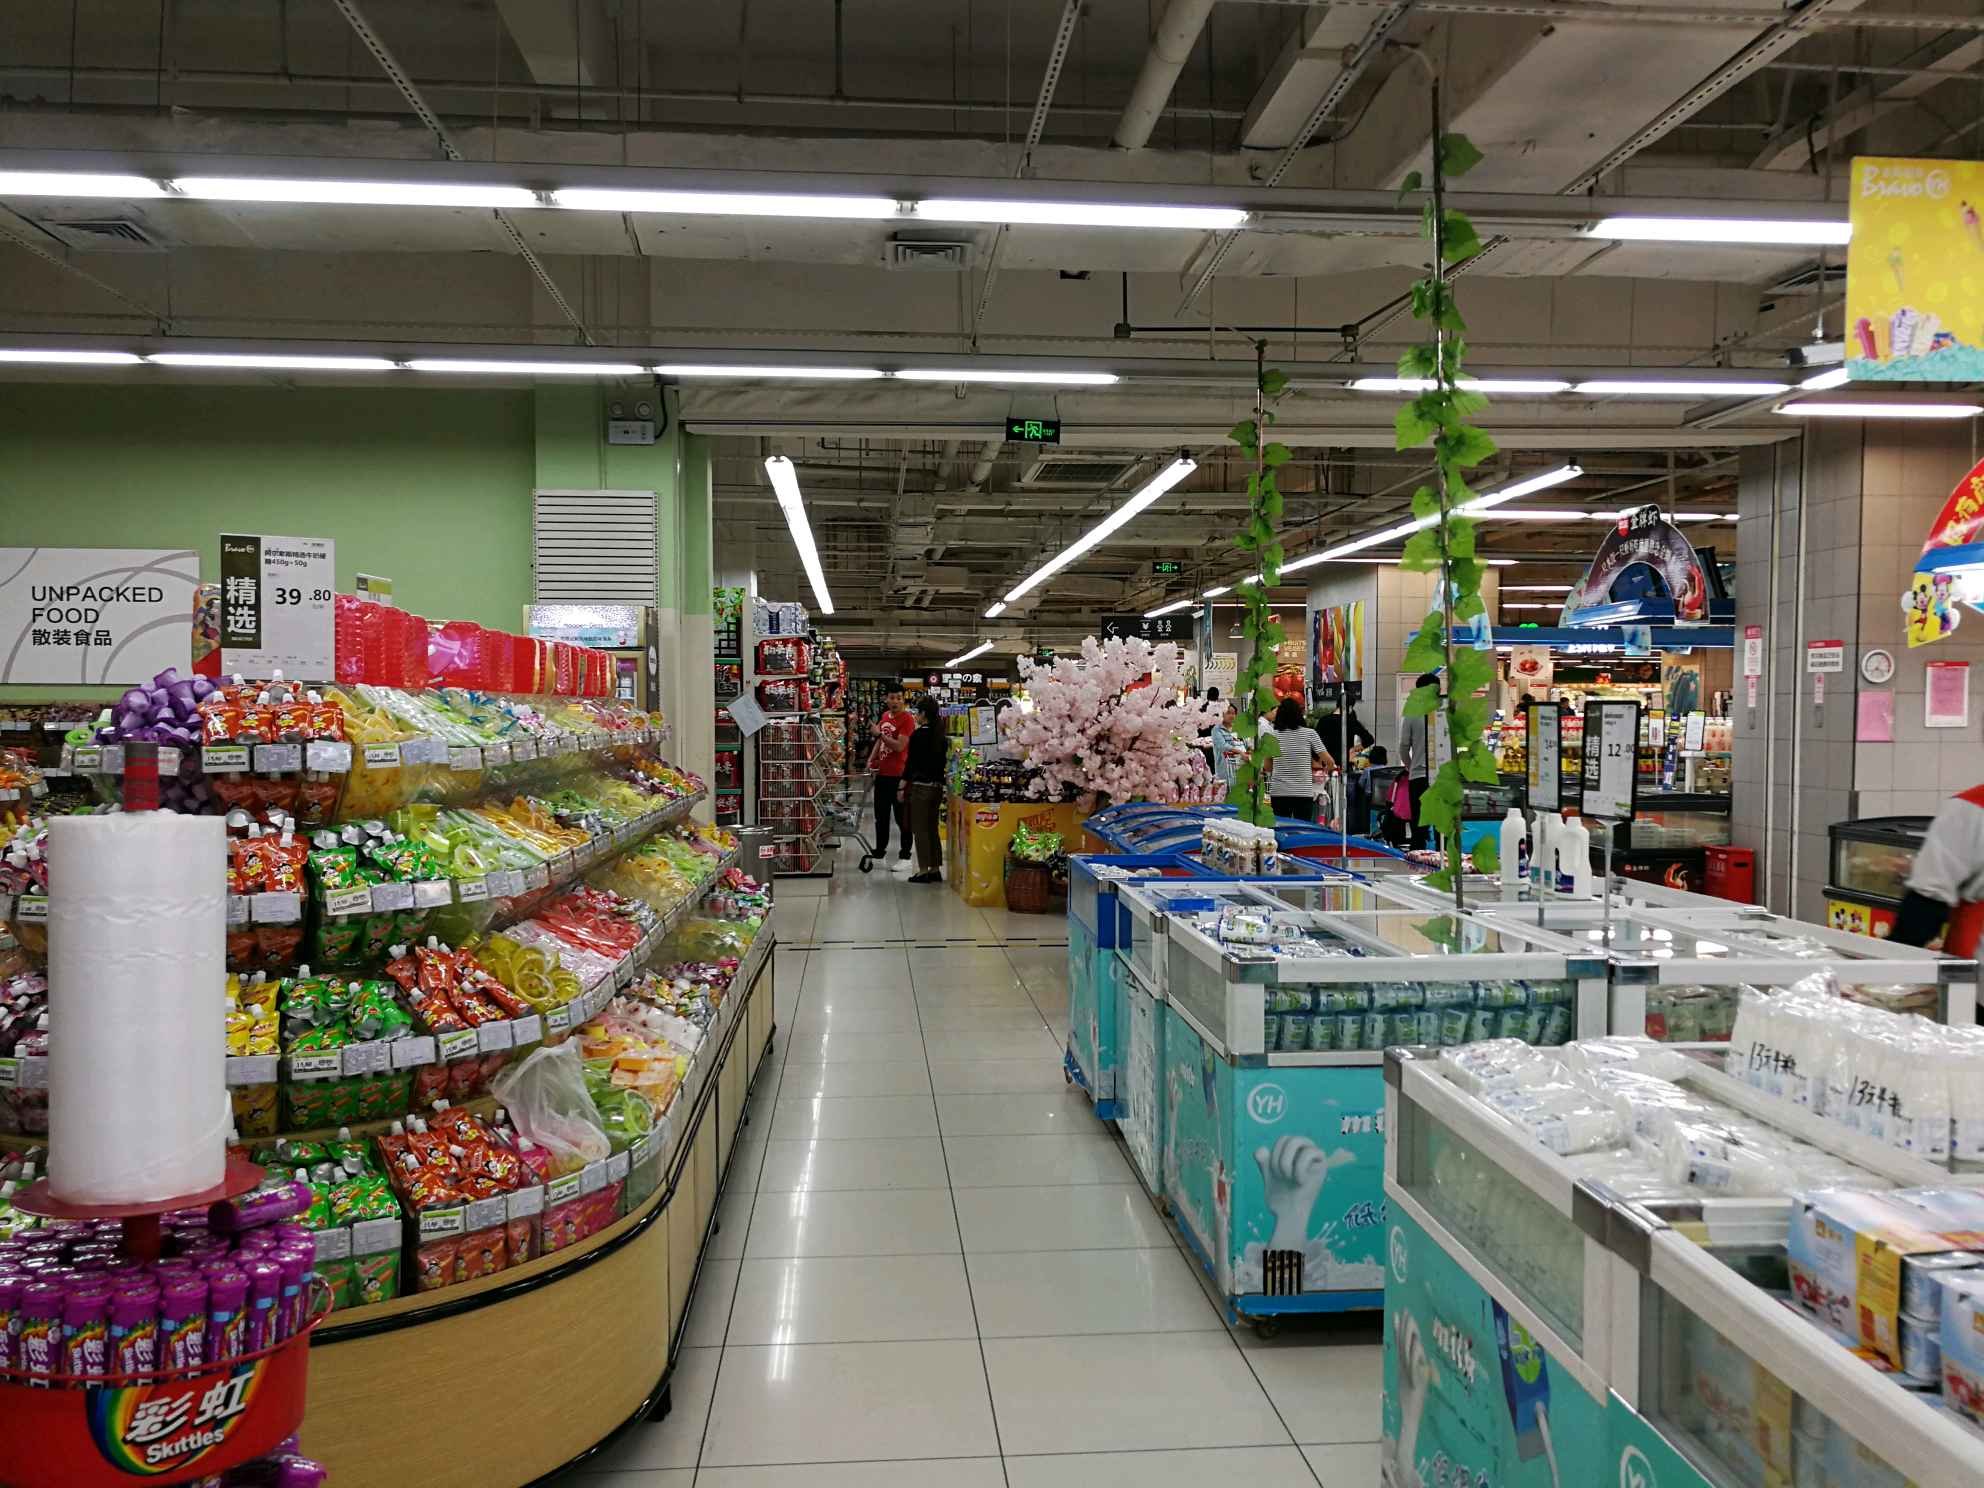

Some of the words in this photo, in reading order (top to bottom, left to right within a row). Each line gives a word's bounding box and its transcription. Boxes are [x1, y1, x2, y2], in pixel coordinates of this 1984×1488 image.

[32, 586, 164, 604] UNPACKED
[275, 587, 302, 606] 39
[308, 589, 332, 602] .80
[226, 576, 257, 634] 精选
[32, 608, 100, 625] FOOD
[31, 629, 113, 647] 散装食品
[1607, 743, 1621, 757] 12
[1253, 1096, 1283, 1114] YH
[124, 1371, 256, 1442] 彩虹
[146, 1427, 225, 1464] Skittles
